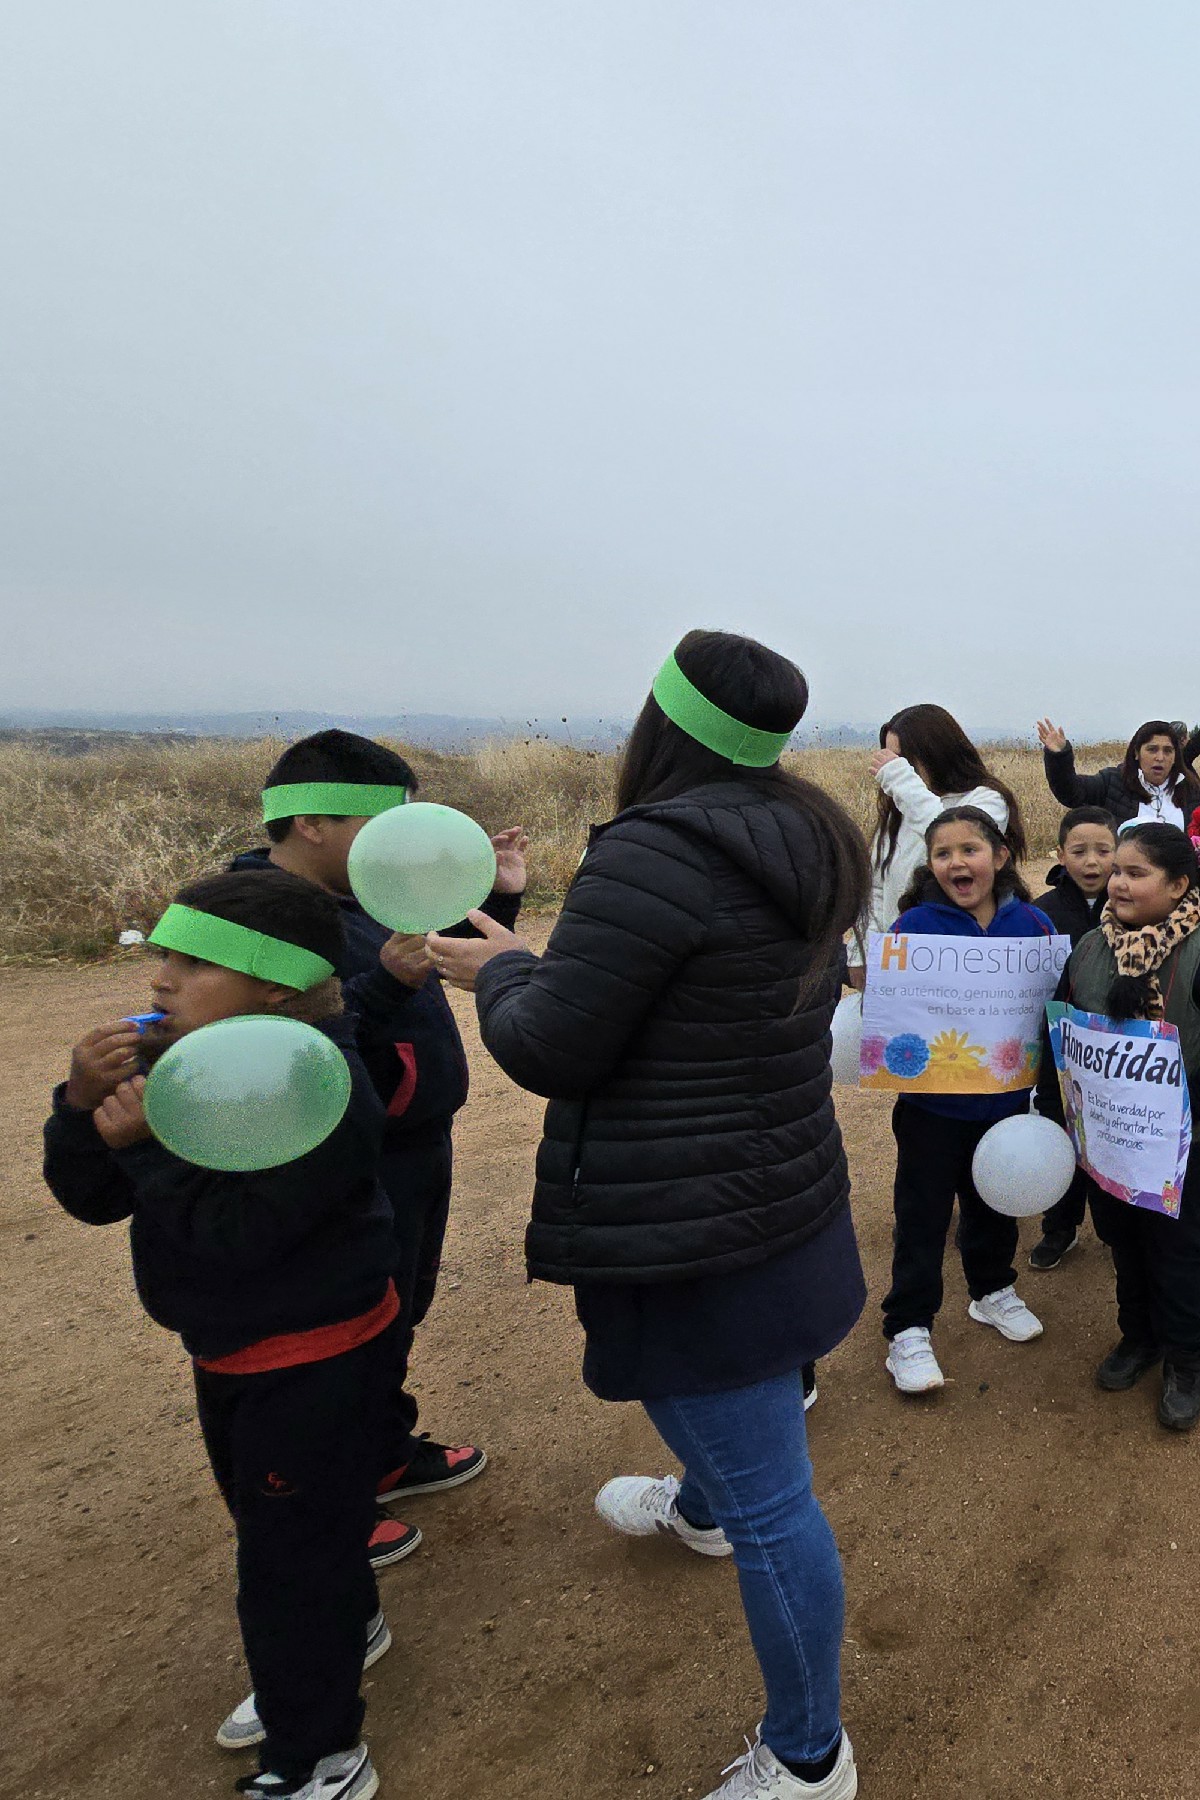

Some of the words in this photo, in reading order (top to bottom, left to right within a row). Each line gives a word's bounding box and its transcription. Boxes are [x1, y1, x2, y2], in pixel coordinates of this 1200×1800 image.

[964, 988, 1017, 1002] genuino,
[928, 1005, 944, 1015] en
[946, 1003, 975, 1016] base
[978, 1007, 986, 1016] a
[989, 1005, 1000, 1016] la
[1060, 1021, 1181, 1088] Honestidad
[1116, 1102, 1147, 1117] verdad
[1148, 1109, 1166, 1124] por
[1111, 1116, 1150, 1135] afrontar
[1150, 1123, 1164, 1138] las
